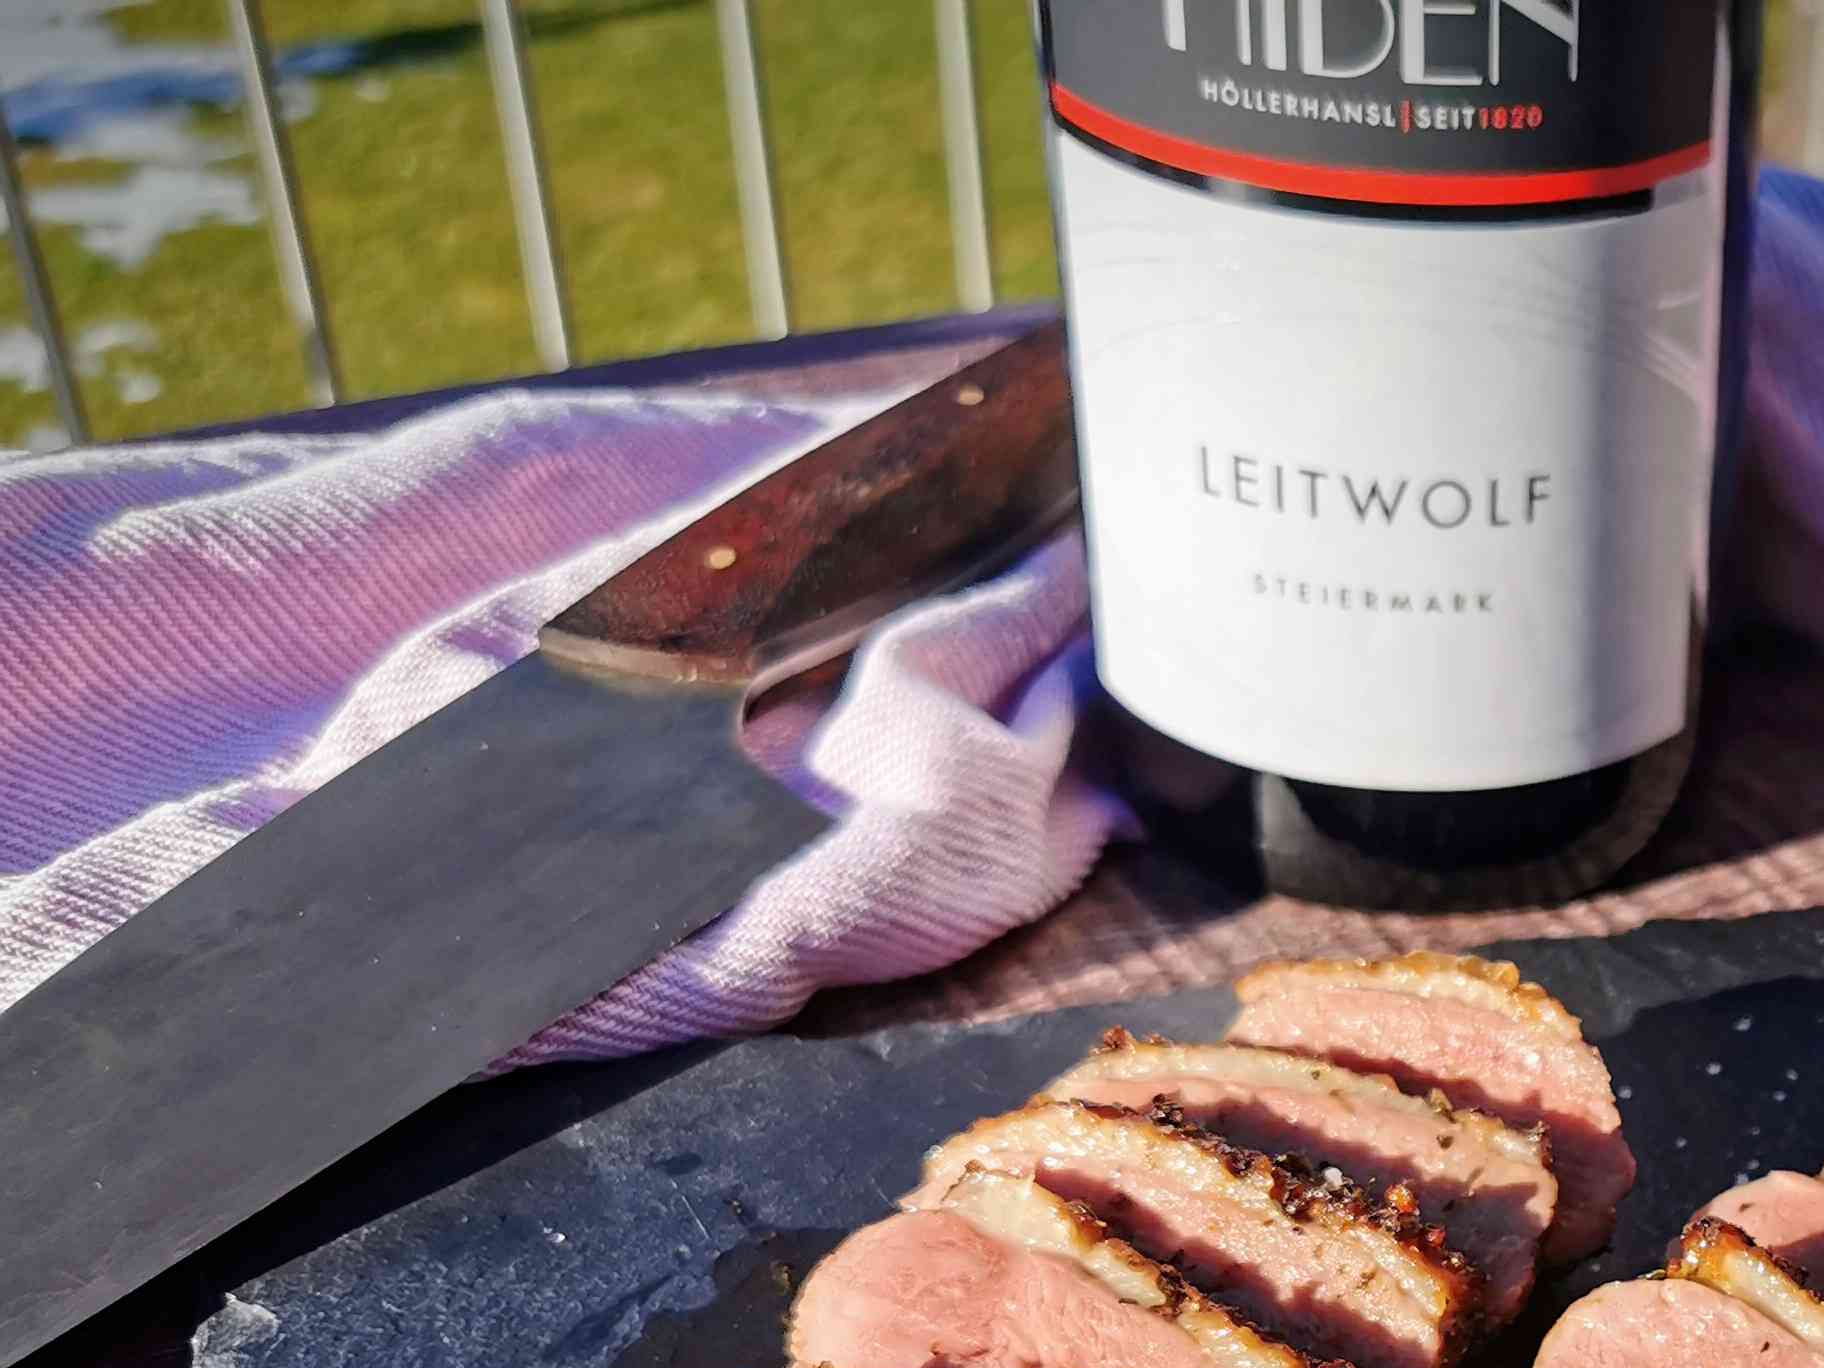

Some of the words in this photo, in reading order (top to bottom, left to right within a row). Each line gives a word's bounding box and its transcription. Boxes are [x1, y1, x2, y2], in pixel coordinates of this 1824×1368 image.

[1201, 78, 1397, 129] HÖLLERHANSL
[1199, 446, 1552, 529] LEITWOLF
[1253, 573, 1495, 614] STEIERMARK
